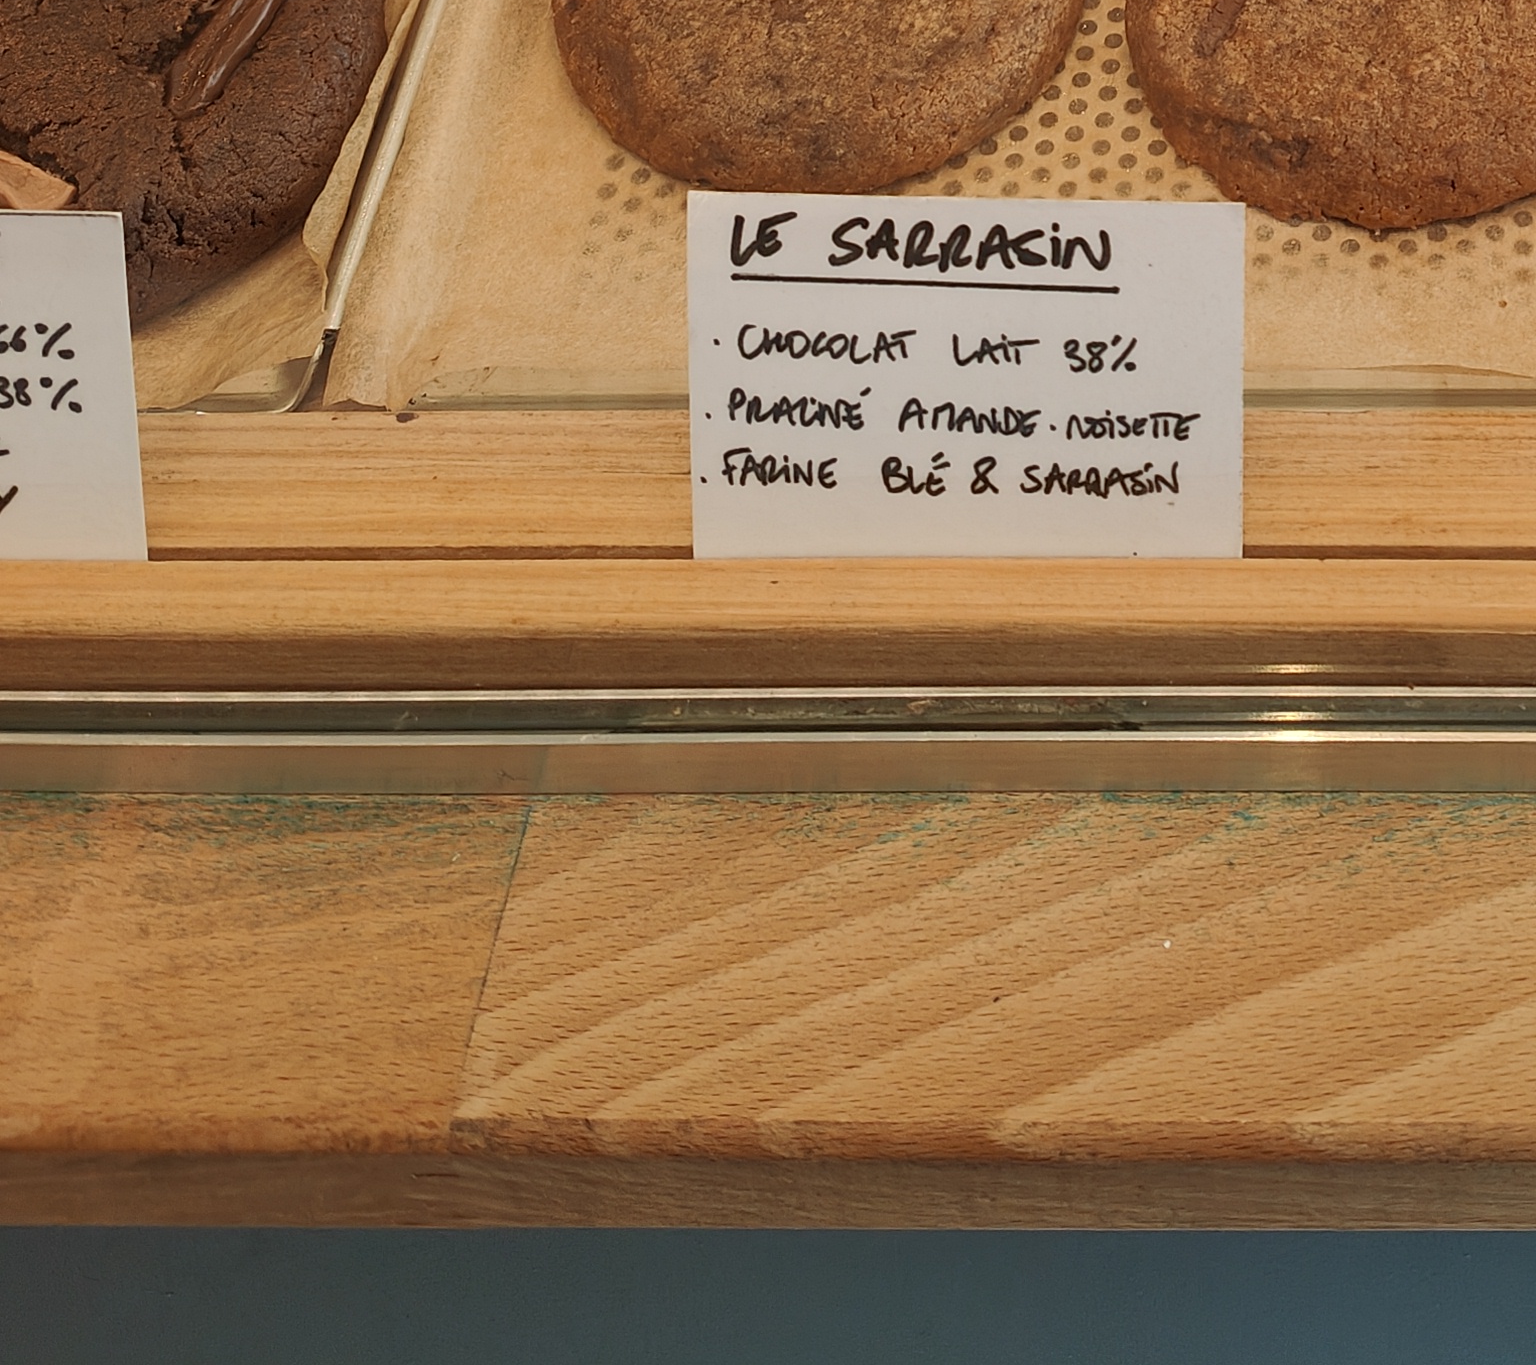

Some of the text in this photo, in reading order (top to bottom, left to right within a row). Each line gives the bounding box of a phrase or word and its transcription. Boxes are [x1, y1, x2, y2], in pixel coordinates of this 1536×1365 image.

[731, 212, 797, 266] LE
[738, 324, 917, 364] CHOCOLAT
[1064, 335, 1138, 373] 38%
[897, 397, 1042, 438] AMANDE
[880, 451, 951, 497] BLÉ
[970, 456, 1000, 495] &
